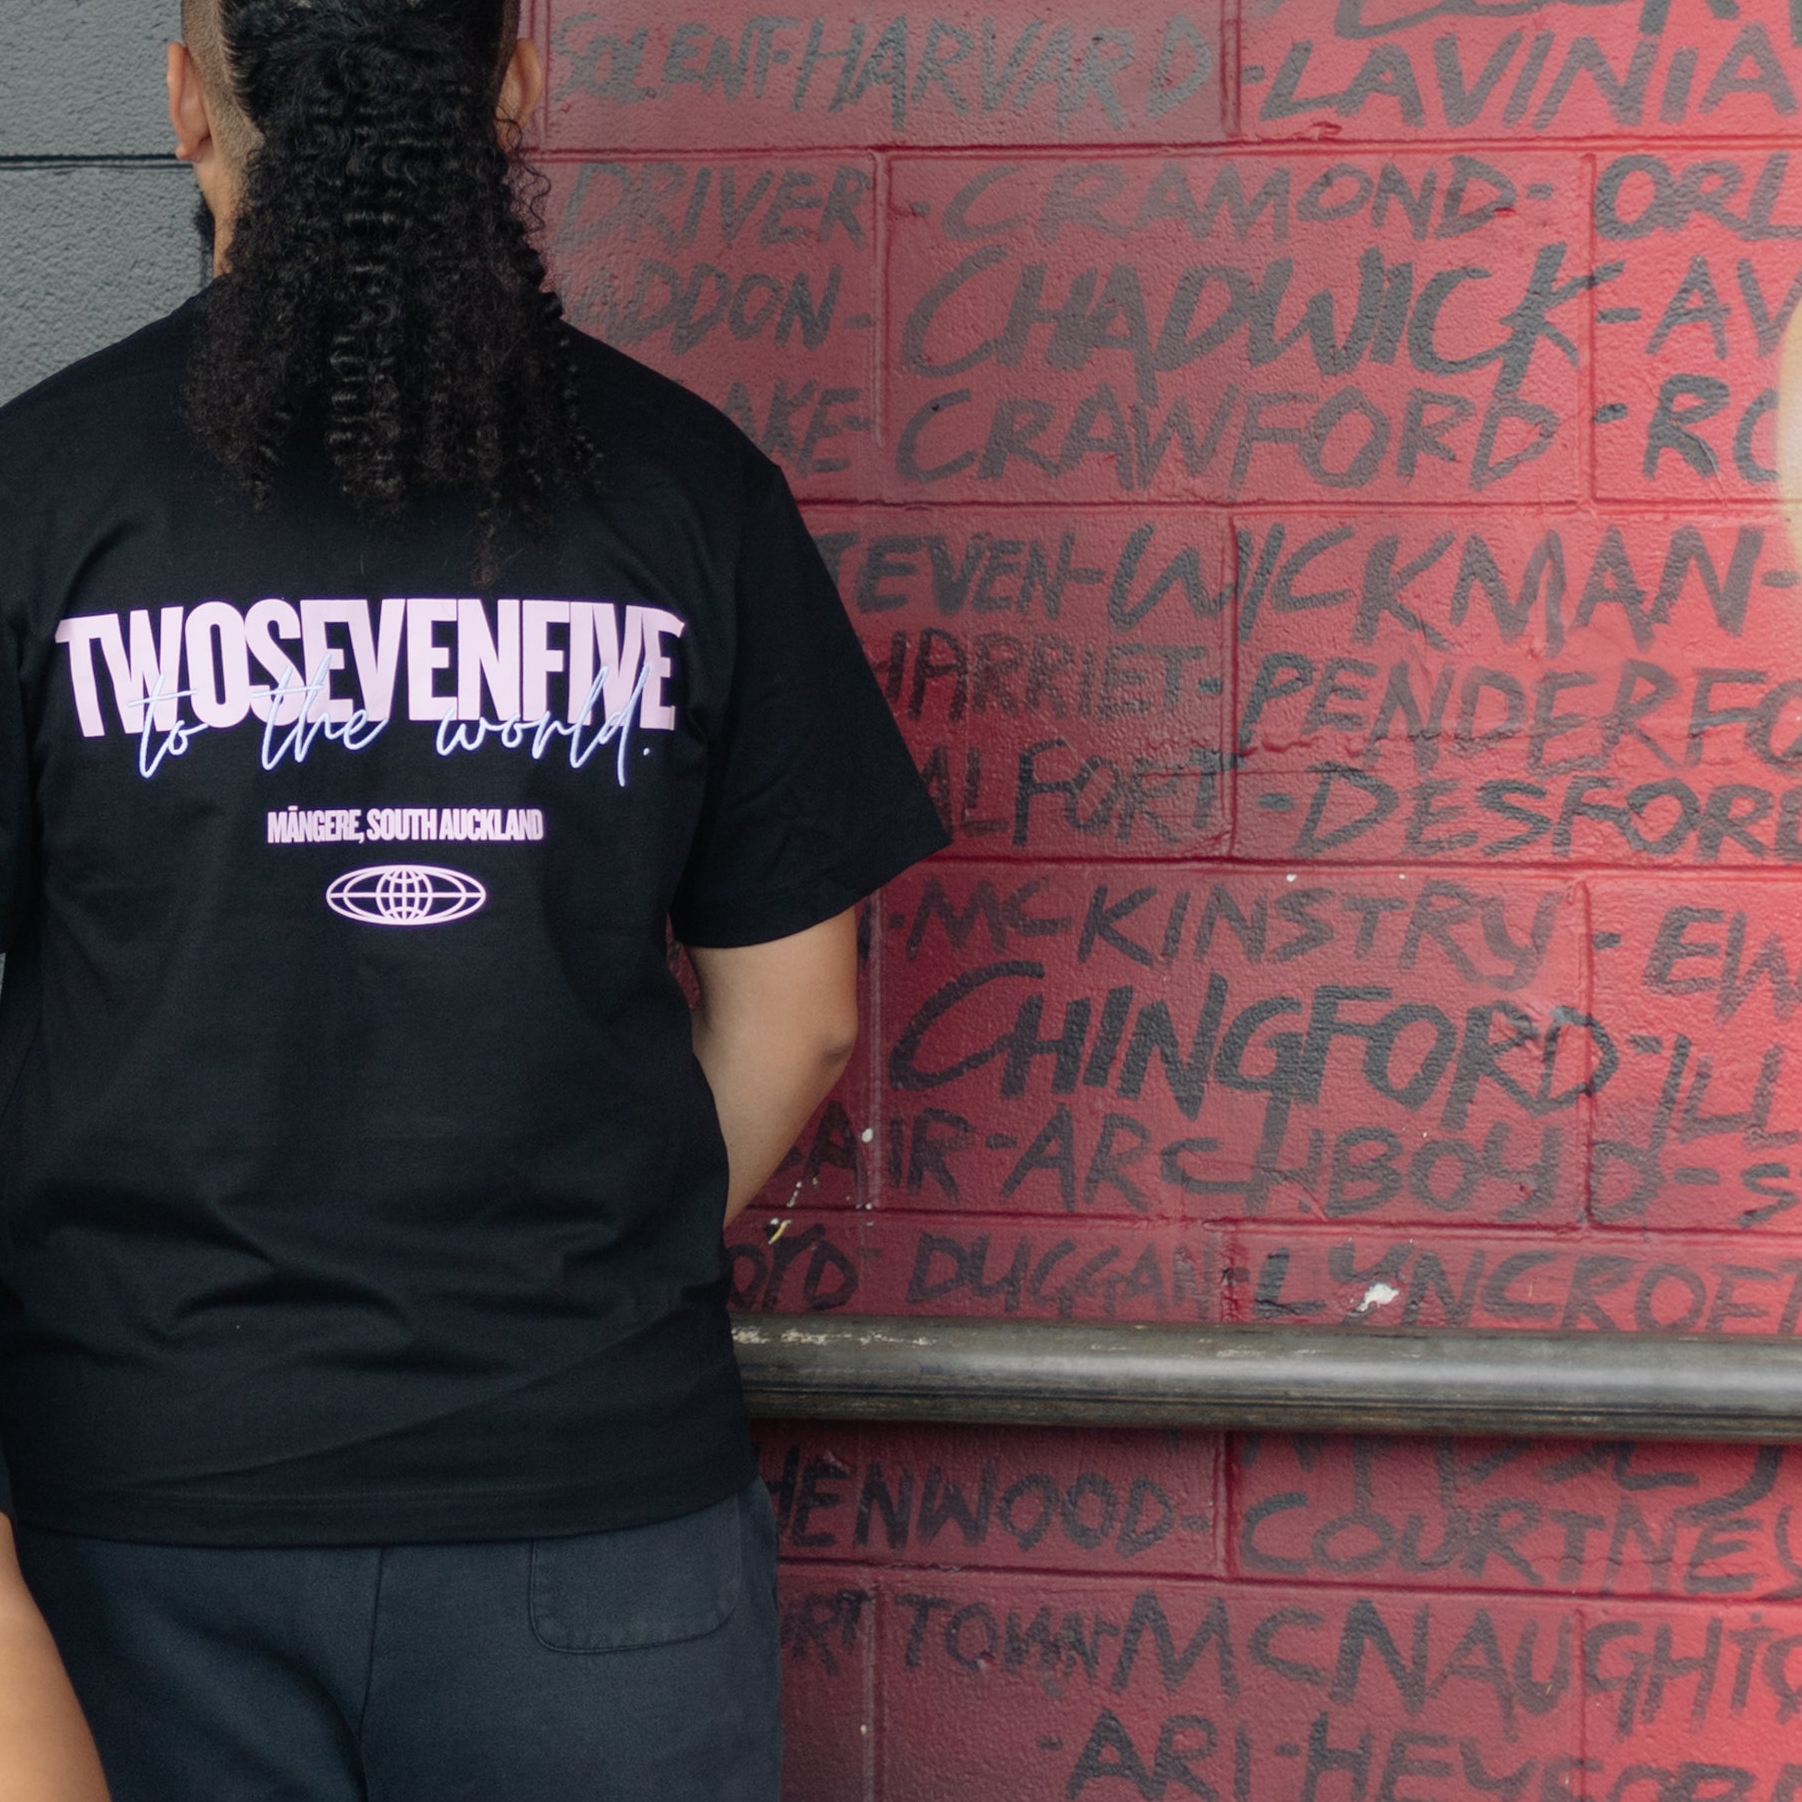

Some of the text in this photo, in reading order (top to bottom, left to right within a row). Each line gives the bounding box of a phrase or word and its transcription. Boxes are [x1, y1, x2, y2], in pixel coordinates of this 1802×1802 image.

[54, 599, 686, 738] TWOSEVENFIVE
[127, 673, 209, 779] to
[252, 653, 392, 771] the
[366, 808, 438, 841] SOUTH
[438, 808, 545, 841] AUCKLAND
